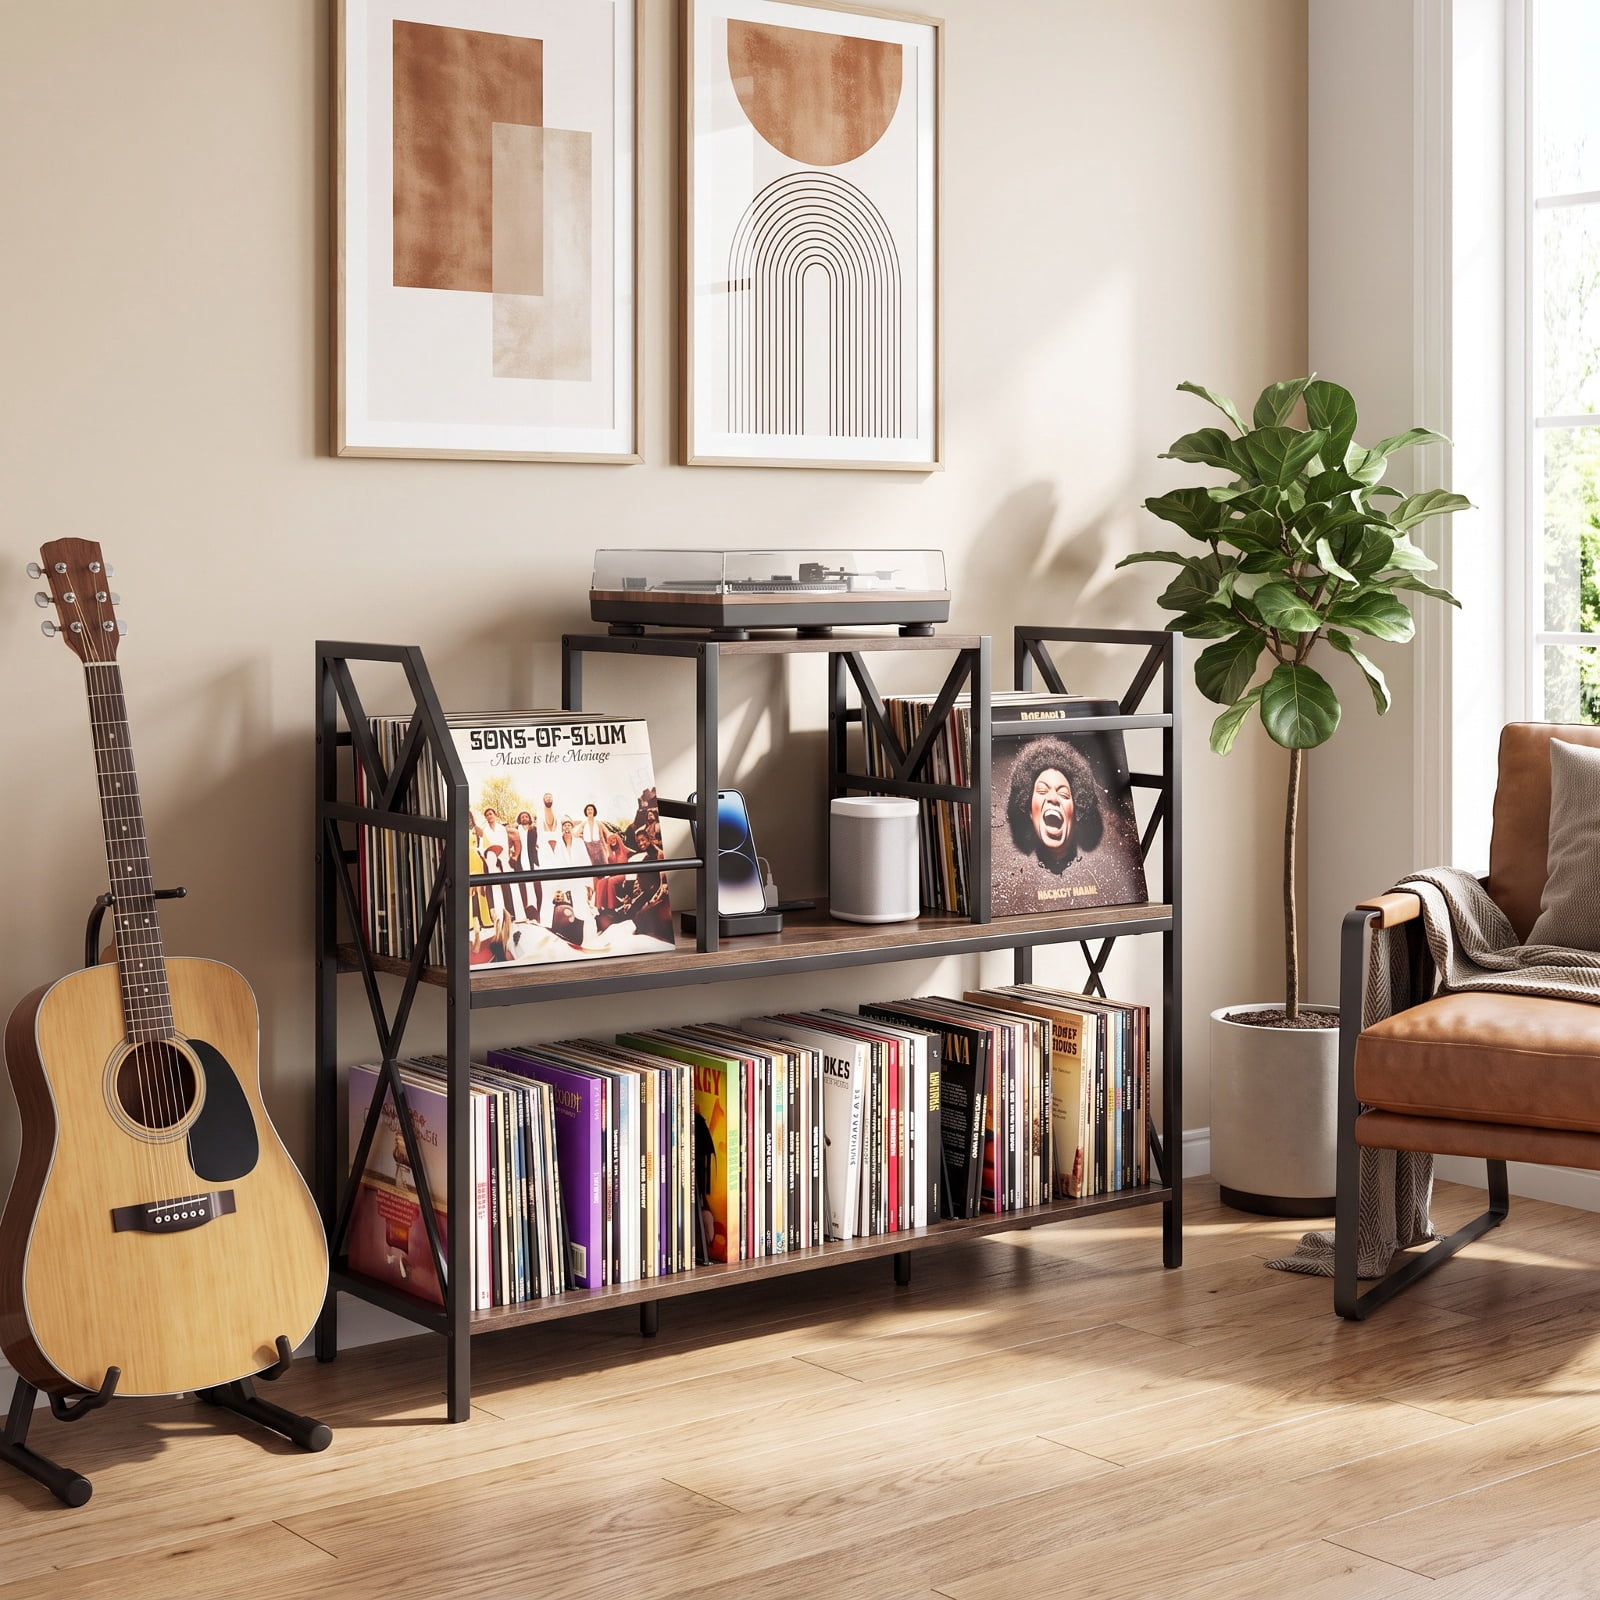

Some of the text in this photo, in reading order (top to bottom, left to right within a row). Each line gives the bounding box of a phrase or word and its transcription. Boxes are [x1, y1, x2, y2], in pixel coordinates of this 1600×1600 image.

[470, 725, 627, 750] SONS-OF-SLUM
[490, 752, 531, 767] Music
[533, 752, 542, 764] is
